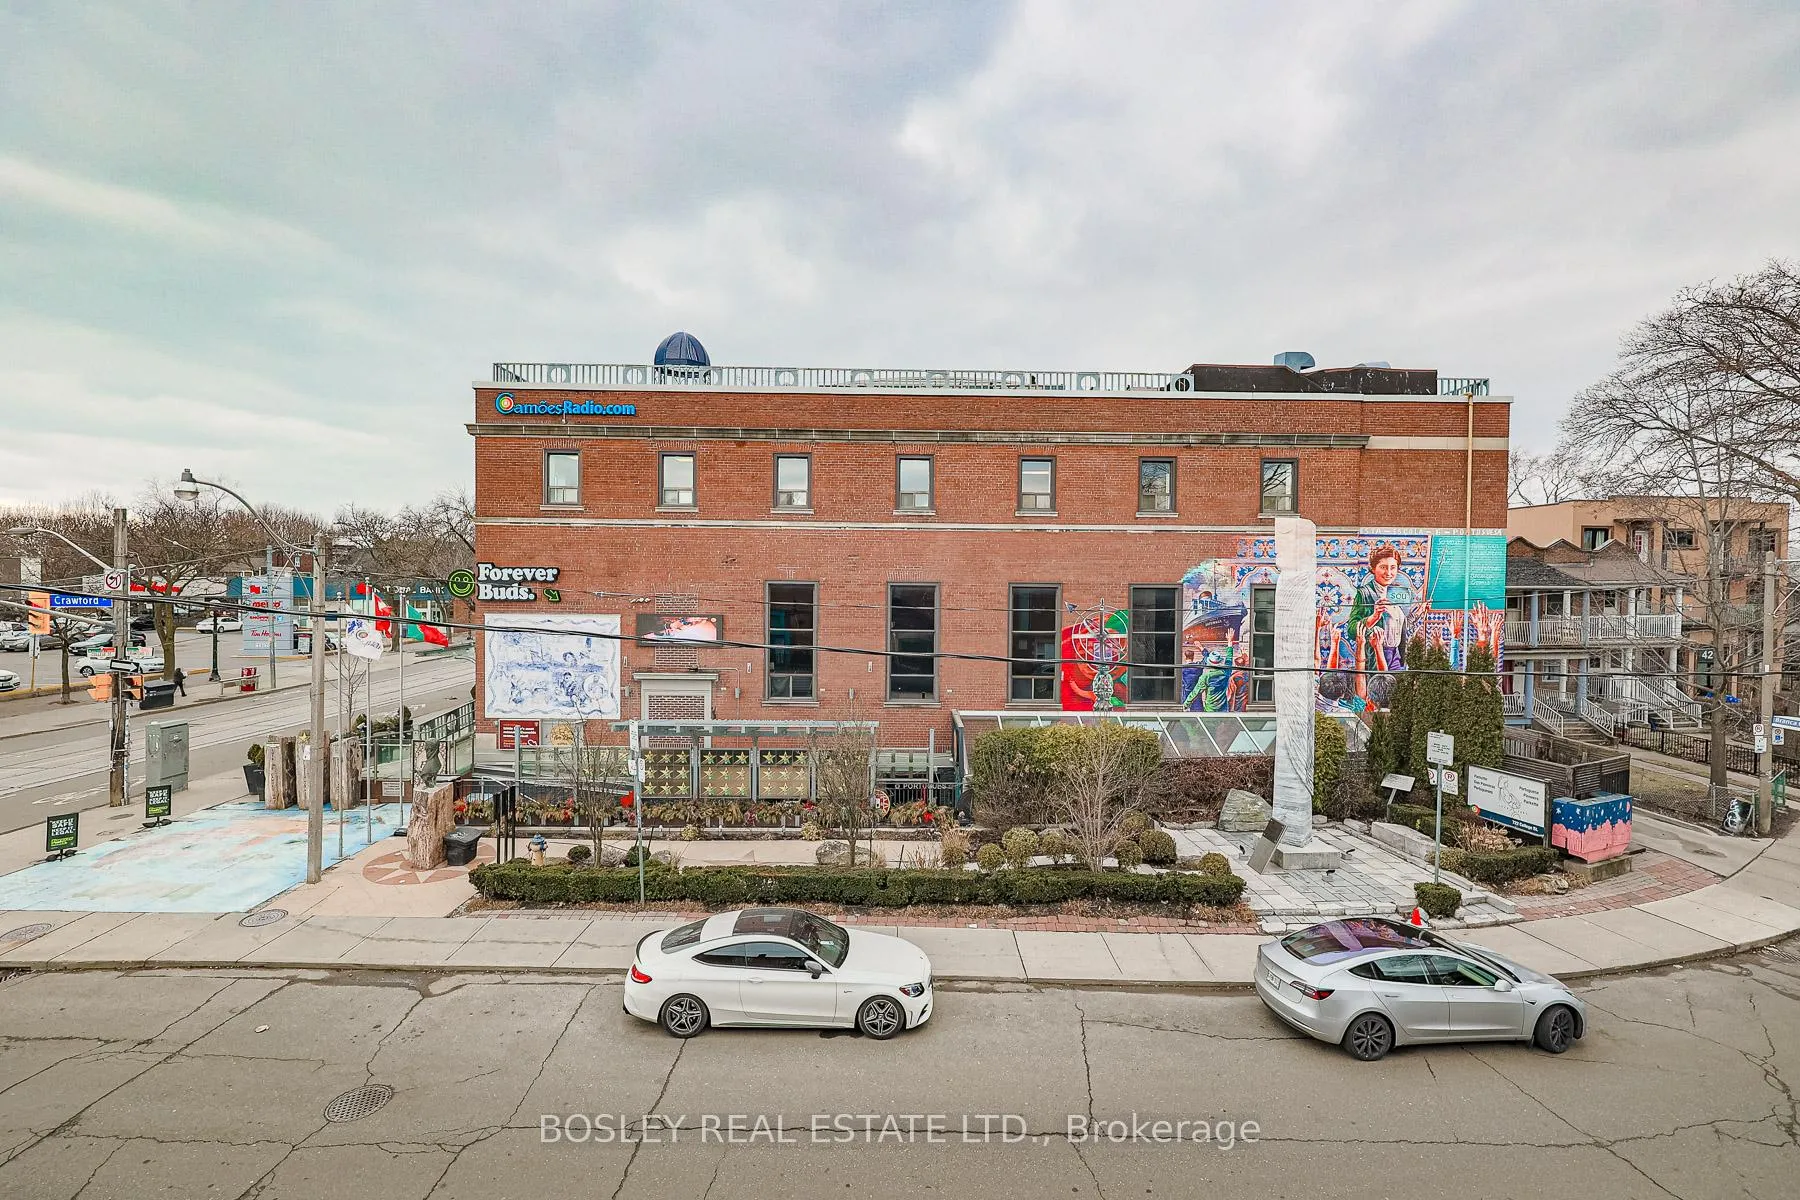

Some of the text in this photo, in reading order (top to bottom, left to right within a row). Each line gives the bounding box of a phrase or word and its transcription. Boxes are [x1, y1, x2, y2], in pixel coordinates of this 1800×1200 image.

[478, 563, 557, 581] Forever
[478, 583, 535, 600] Buds.
[54, 596, 99, 605] Crawford
[1701, 650, 1714, 660] 42
